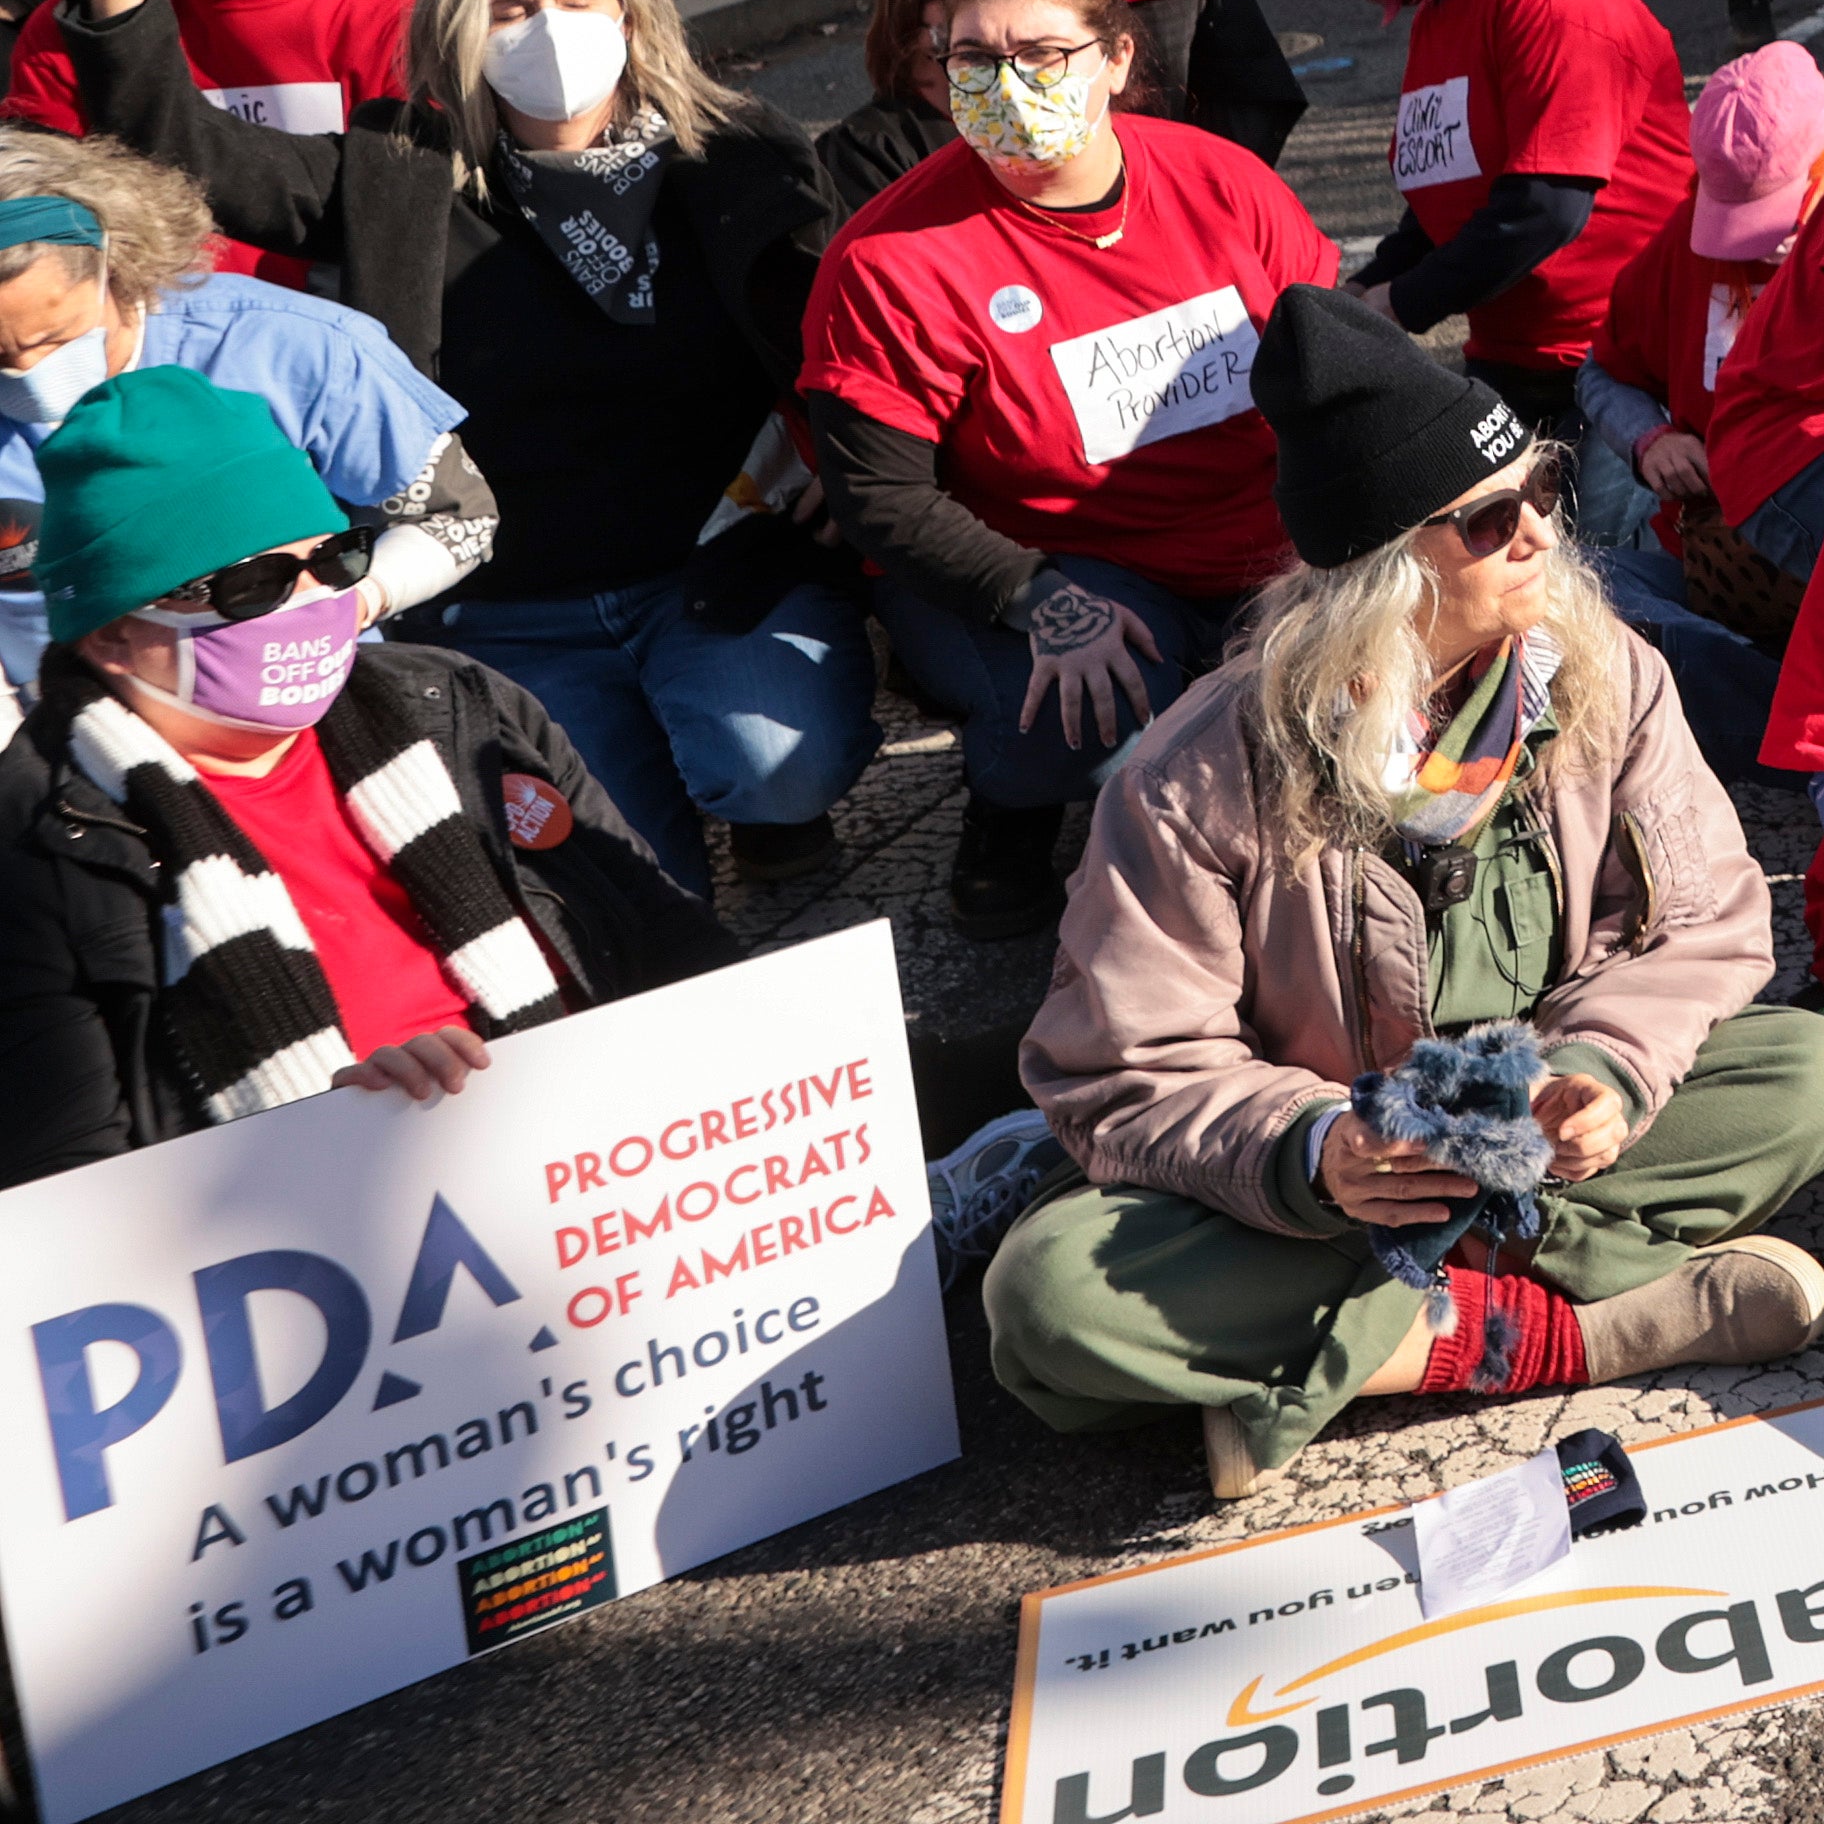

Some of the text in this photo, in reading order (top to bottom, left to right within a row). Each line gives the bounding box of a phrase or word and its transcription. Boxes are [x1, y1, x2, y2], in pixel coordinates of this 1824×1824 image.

[1482, 430, 1515, 464] YOU
[261, 661, 316, 684] OFF
[263, 635, 331, 663] BANS
[544, 1060, 873, 1203] PROGRESSIVE
[555, 1124, 872, 1269] DEMOCRATS
[565, 1185, 896, 1331] OF AMERICA
[30, 1192, 563, 1521] PDA
[192, 1293, 820, 1560] A woman's choice
[191, 1599, 249, 1654] is
[273, 1577, 313, 1620] a
[337, 1445, 655, 1595] woman's
[677, 1368, 828, 1464] right
[1655, 1490, 1736, 1523] you
[1065, 1572, 1424, 1673] en you want it.
